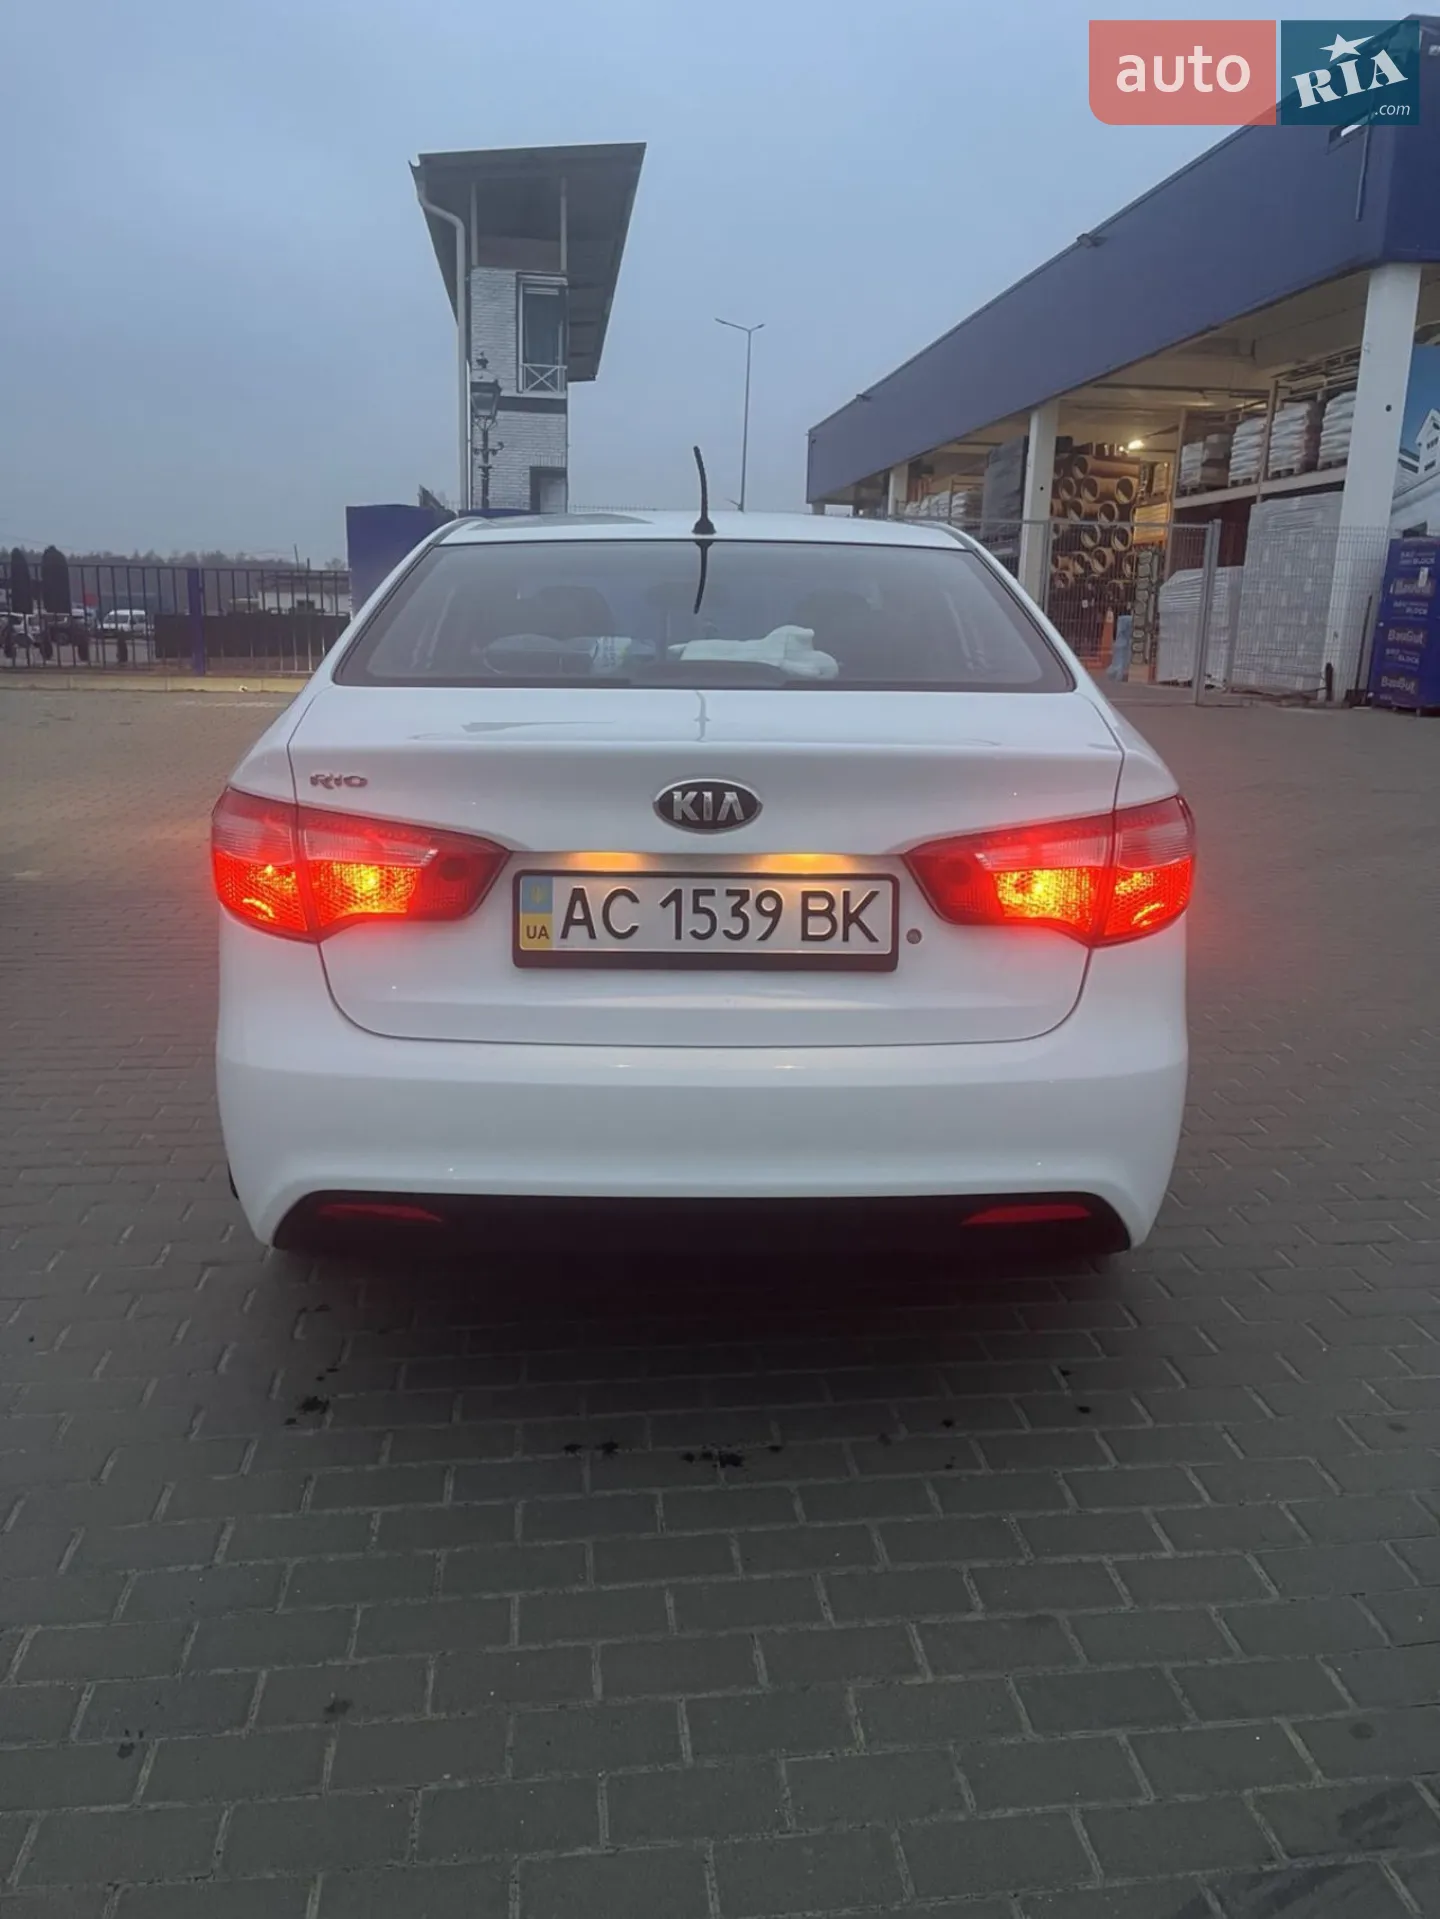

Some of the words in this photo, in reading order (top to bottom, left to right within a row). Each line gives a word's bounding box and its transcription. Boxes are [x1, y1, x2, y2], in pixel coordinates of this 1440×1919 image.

[309, 773, 369, 790] RIO
[672, 790, 745, 821] KIA
[526, 925, 550, 940] UA
[560, 886, 640, 941] AC
[659, 888, 784, 942] 1539
[801, 890, 880, 943] BK
